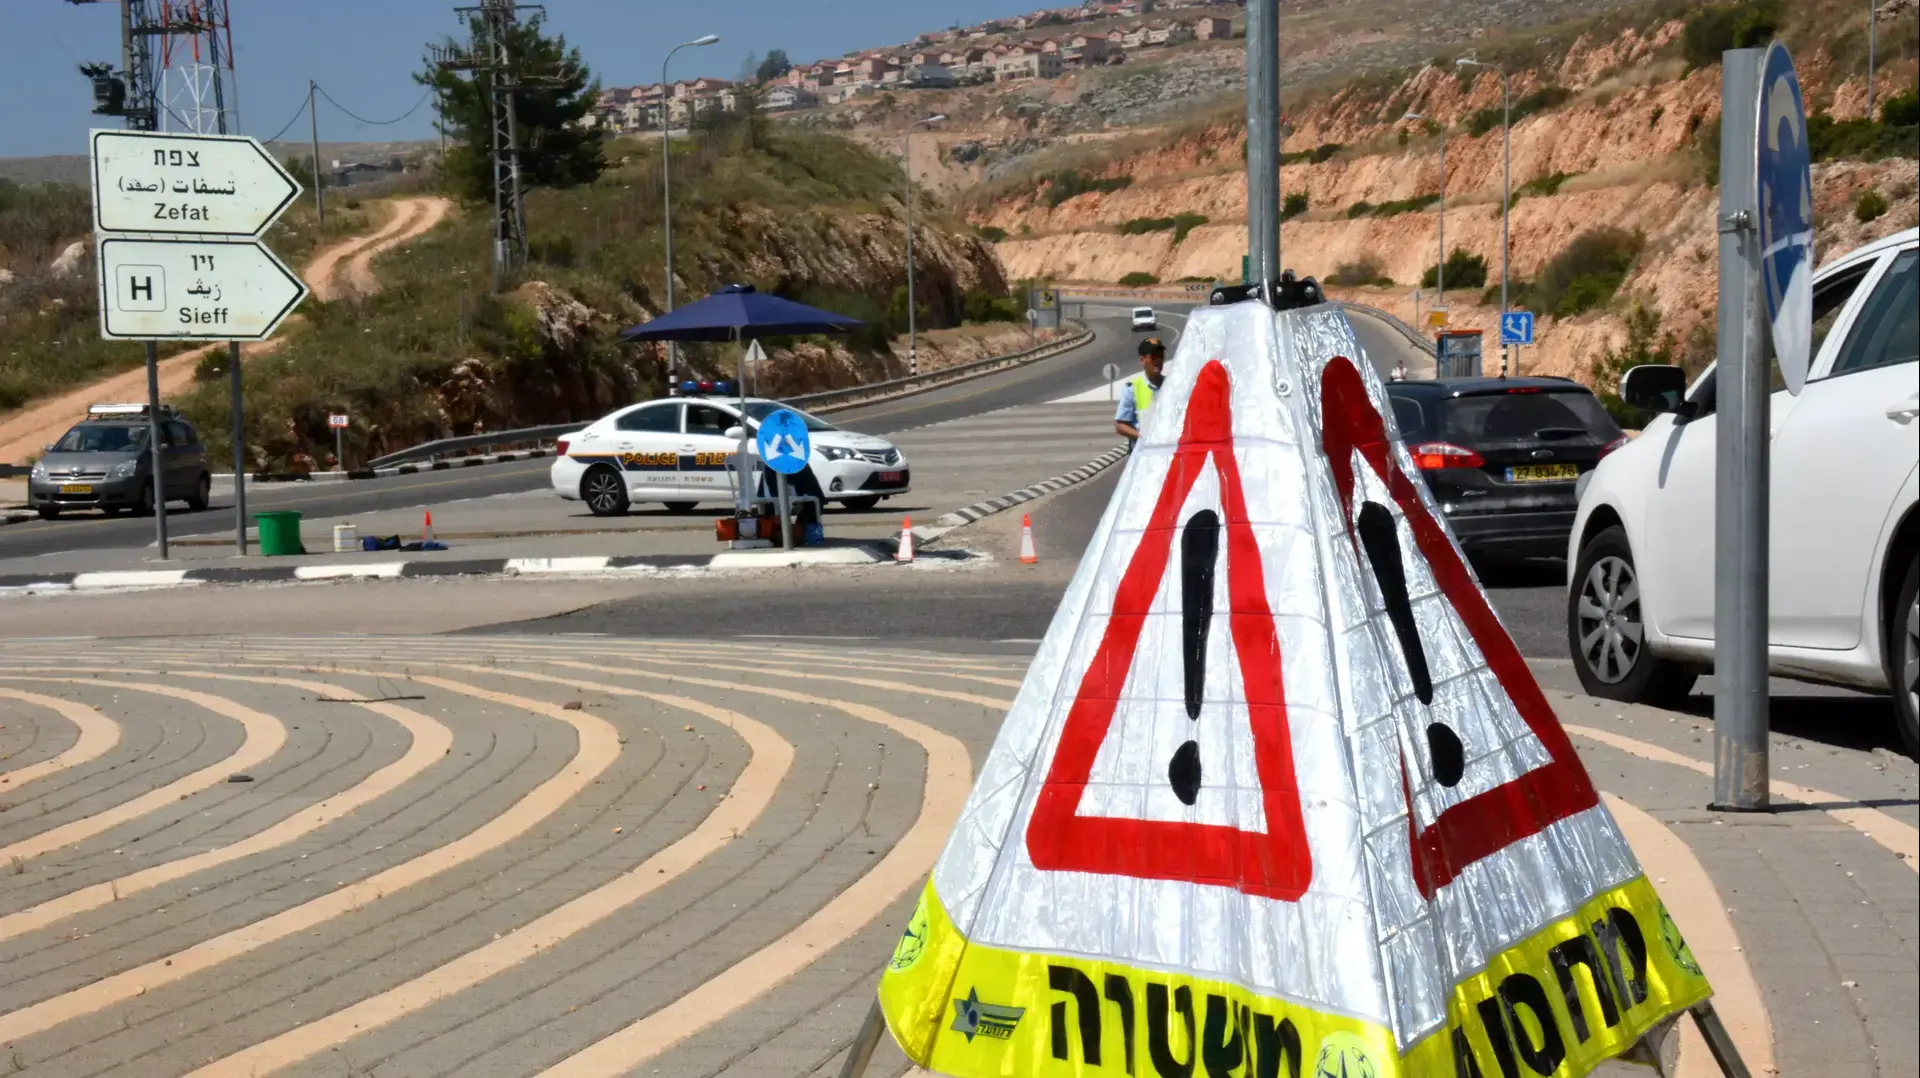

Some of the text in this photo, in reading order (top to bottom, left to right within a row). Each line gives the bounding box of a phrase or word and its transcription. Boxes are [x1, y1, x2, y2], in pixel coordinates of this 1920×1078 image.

[153, 149, 200, 167] צפת
[118, 176, 236, 196] تسفات (صفد)
[153, 203, 209, 220] Zefat
[191, 254, 214, 271] זיו
[130, 276, 152, 300] H
[179, 308, 228, 324] Sieff
[623, 452, 677, 466] POLICE
[695, 452, 736, 466] טרה
[1047, 964, 1302, 1078] משטרה
